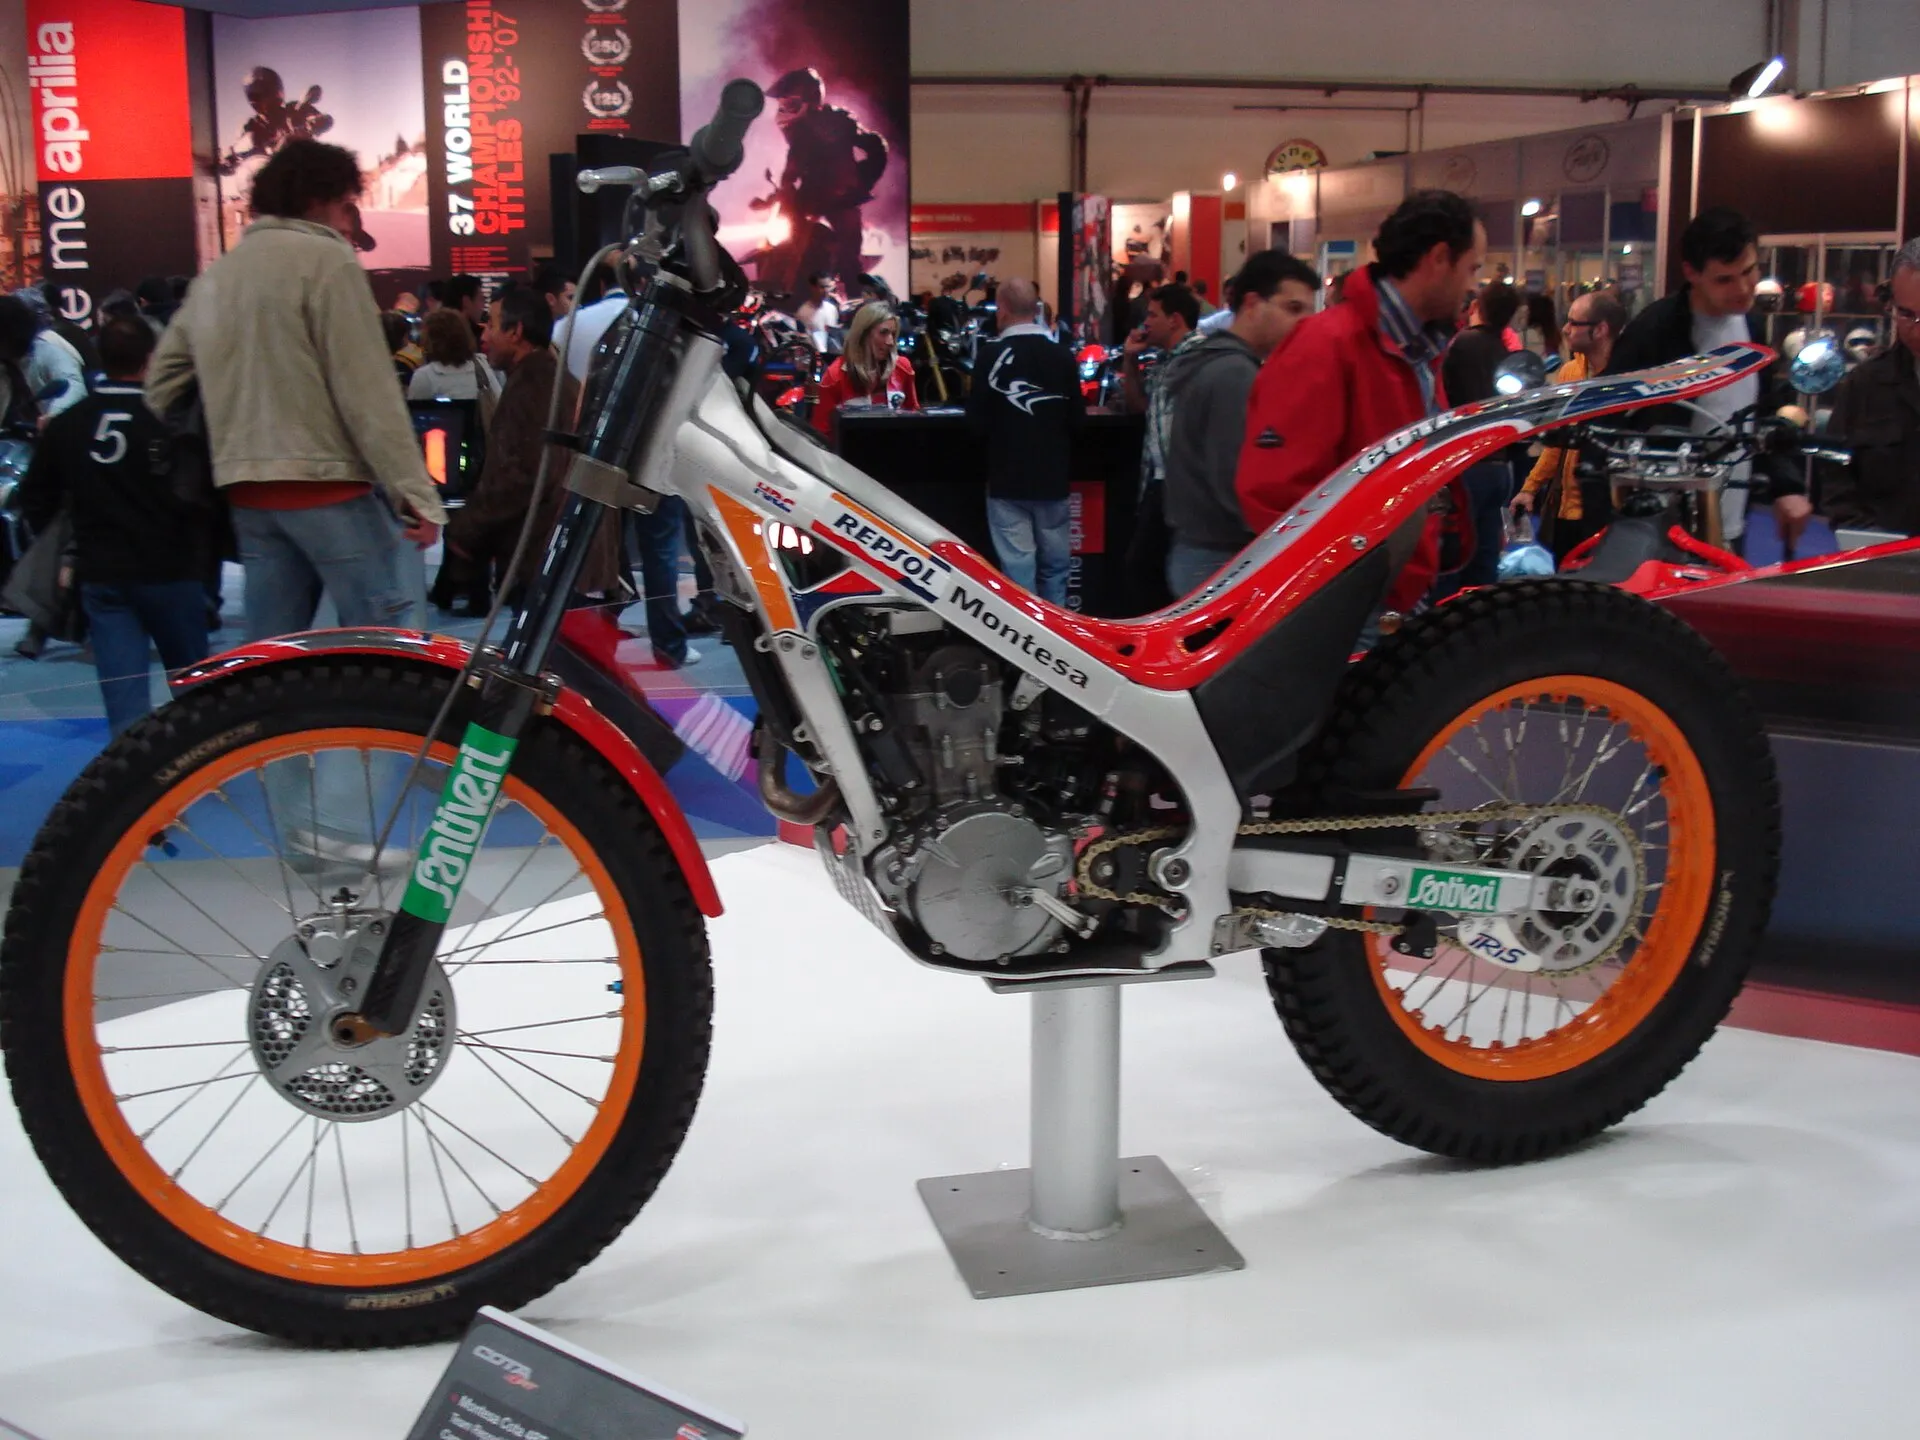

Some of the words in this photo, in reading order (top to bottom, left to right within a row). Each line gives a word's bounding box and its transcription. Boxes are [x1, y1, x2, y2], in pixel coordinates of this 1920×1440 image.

[28, 21, 90, 174] aprilia
[443, 59, 473, 184] WORLD
[448, 194, 475, 235] 37
[496, 118, 526, 235] TITLES
[47, 187, 89, 270] me
[89, 412, 134, 464] 5
[833, 513, 938, 586] REPSOL
[950, 586, 1090, 690] Montesa
[472, 1345, 532, 1380] COTA
